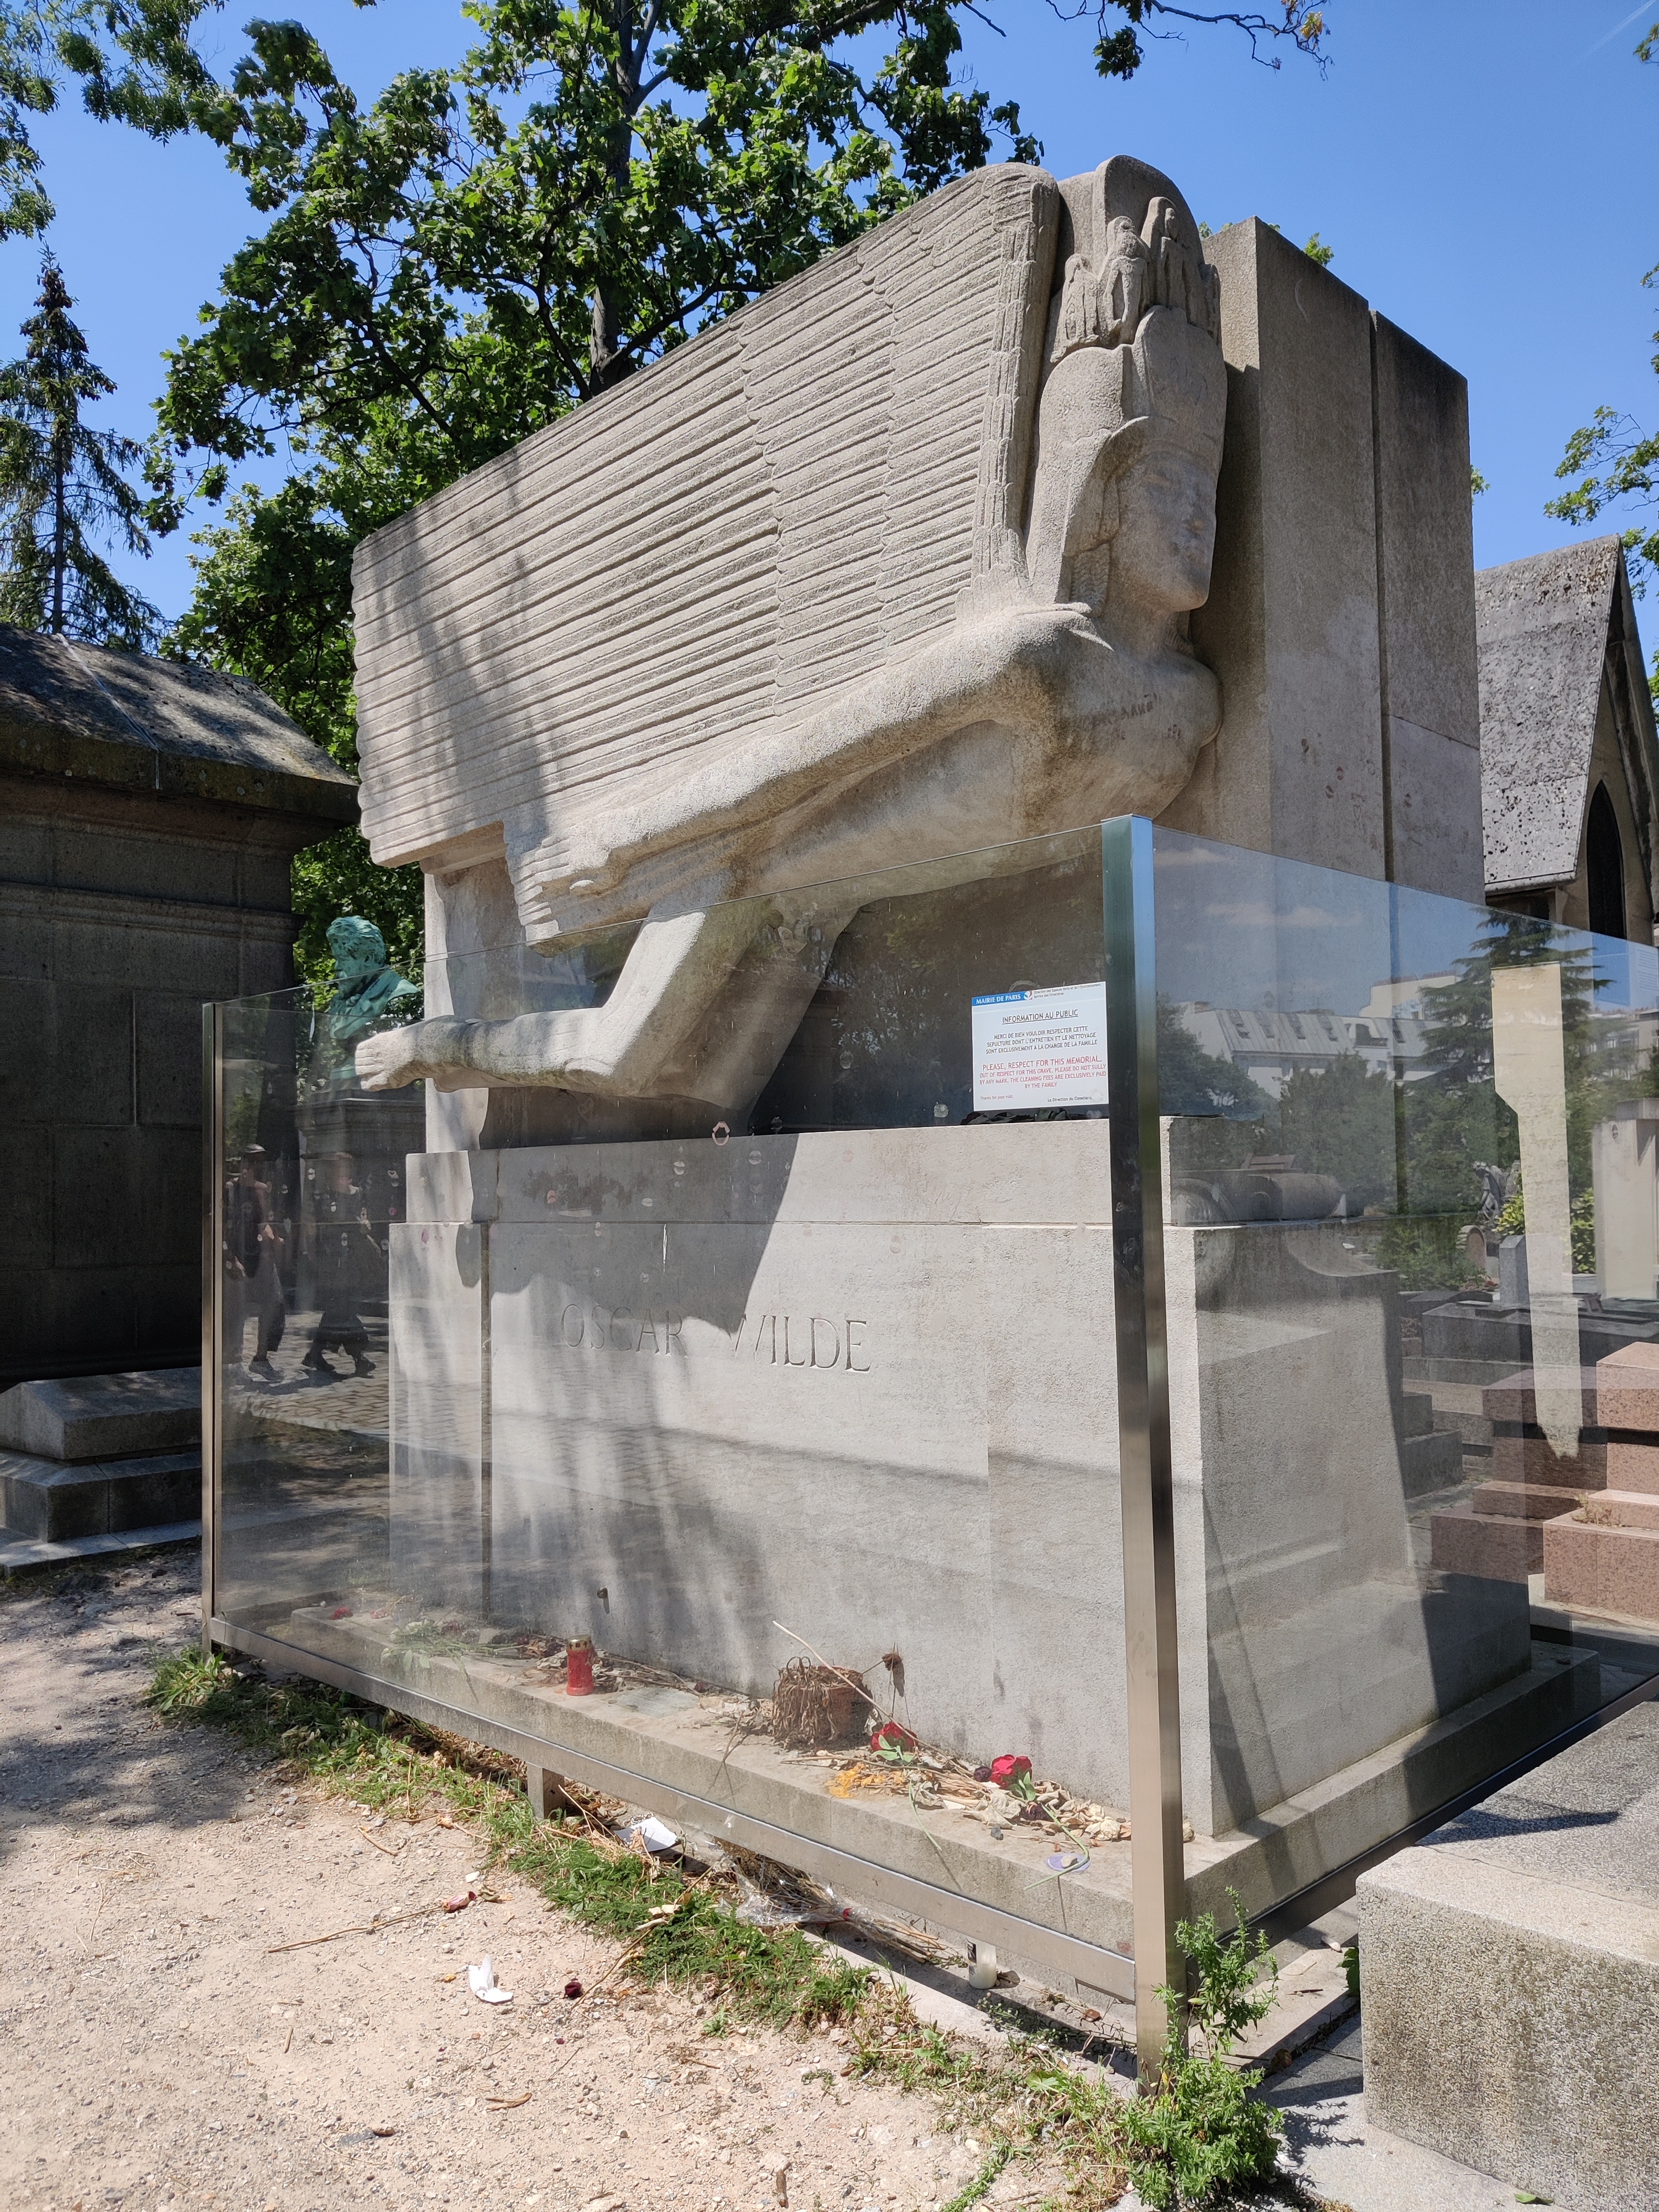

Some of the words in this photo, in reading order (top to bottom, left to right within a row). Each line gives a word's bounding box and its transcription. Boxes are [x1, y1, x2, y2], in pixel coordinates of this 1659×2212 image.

[1002, 1013, 1044, 1023] INFORMATION
[1056, 1009, 1078, 1018] PUBLIC
[1008, 1061, 1034, 1069] RESPECT
[561, 1303, 688, 1359] OSCAR
